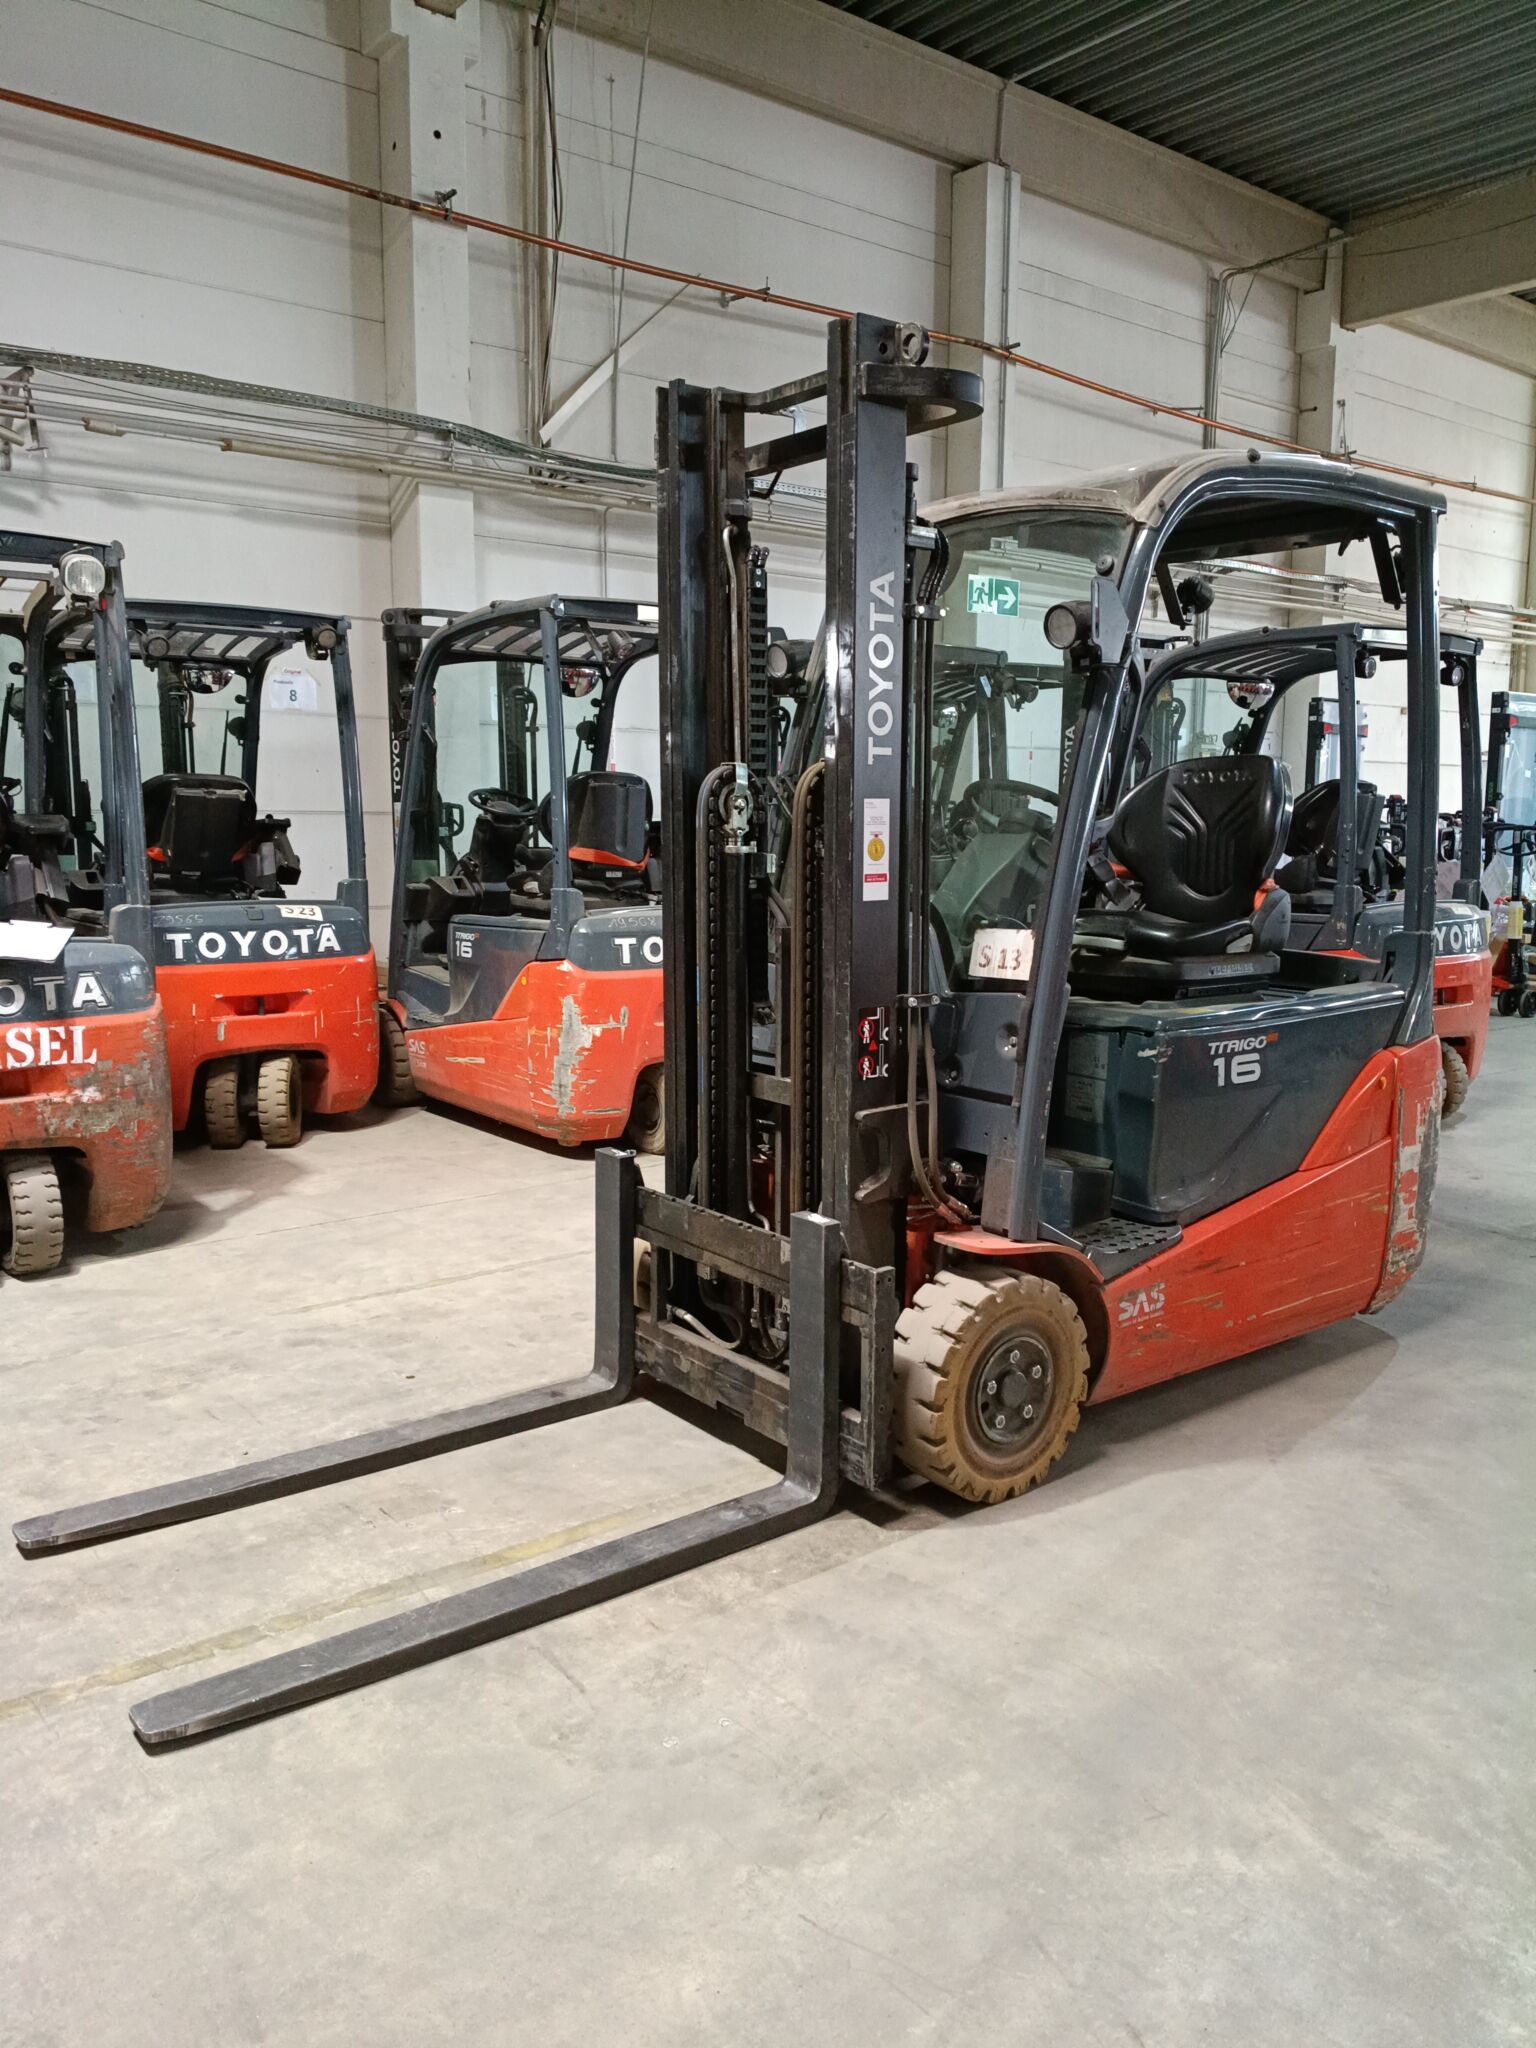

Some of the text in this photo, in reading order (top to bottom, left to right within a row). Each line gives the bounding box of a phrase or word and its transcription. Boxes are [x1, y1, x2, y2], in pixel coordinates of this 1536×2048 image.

[867, 571, 895, 765] TOYOTA
[289, 689, 298, 702] 8
[298, 907, 317, 916] 23
[165, 926, 342, 960] TOYOTA
[455, 940, 473, 958] 16
[613, 936, 664, 964] TO
[978, 944, 1022, 971] S 13
[0, 972, 109, 1015] OTA
[0, 1025, 97, 1070] SEL
[1208, 1036, 1268, 1056] TRAIGO
[1213, 1052, 1262, 1088] 16
[1118, 1282, 1167, 1322] SAS
